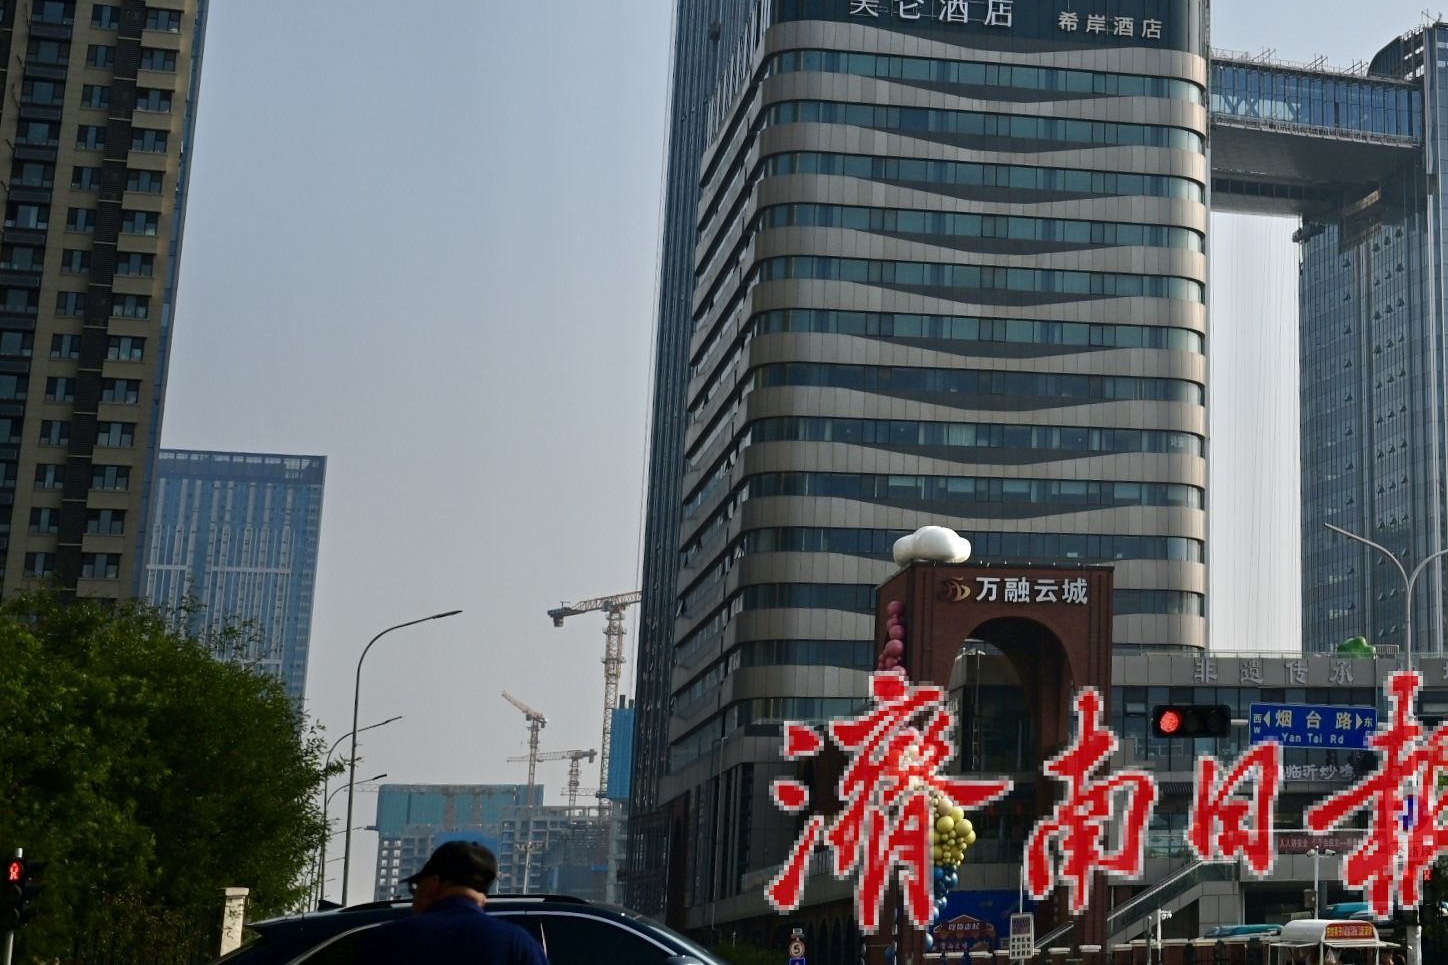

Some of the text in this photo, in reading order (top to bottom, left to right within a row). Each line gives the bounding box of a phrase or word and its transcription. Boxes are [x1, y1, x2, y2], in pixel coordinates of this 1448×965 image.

[1057, 11, 1163, 40] 希岸酒店
[975, 575, 1088, 605] 万融云城
[1193, 659, 1355, 684] 非遗传承
[1253, 713, 1262, 724] 西
[1275, 709, 1352, 731] 烟台路
[1282, 732, 1344, 744] Yan Tai Rd
[793, 944, 800, 954] 5
